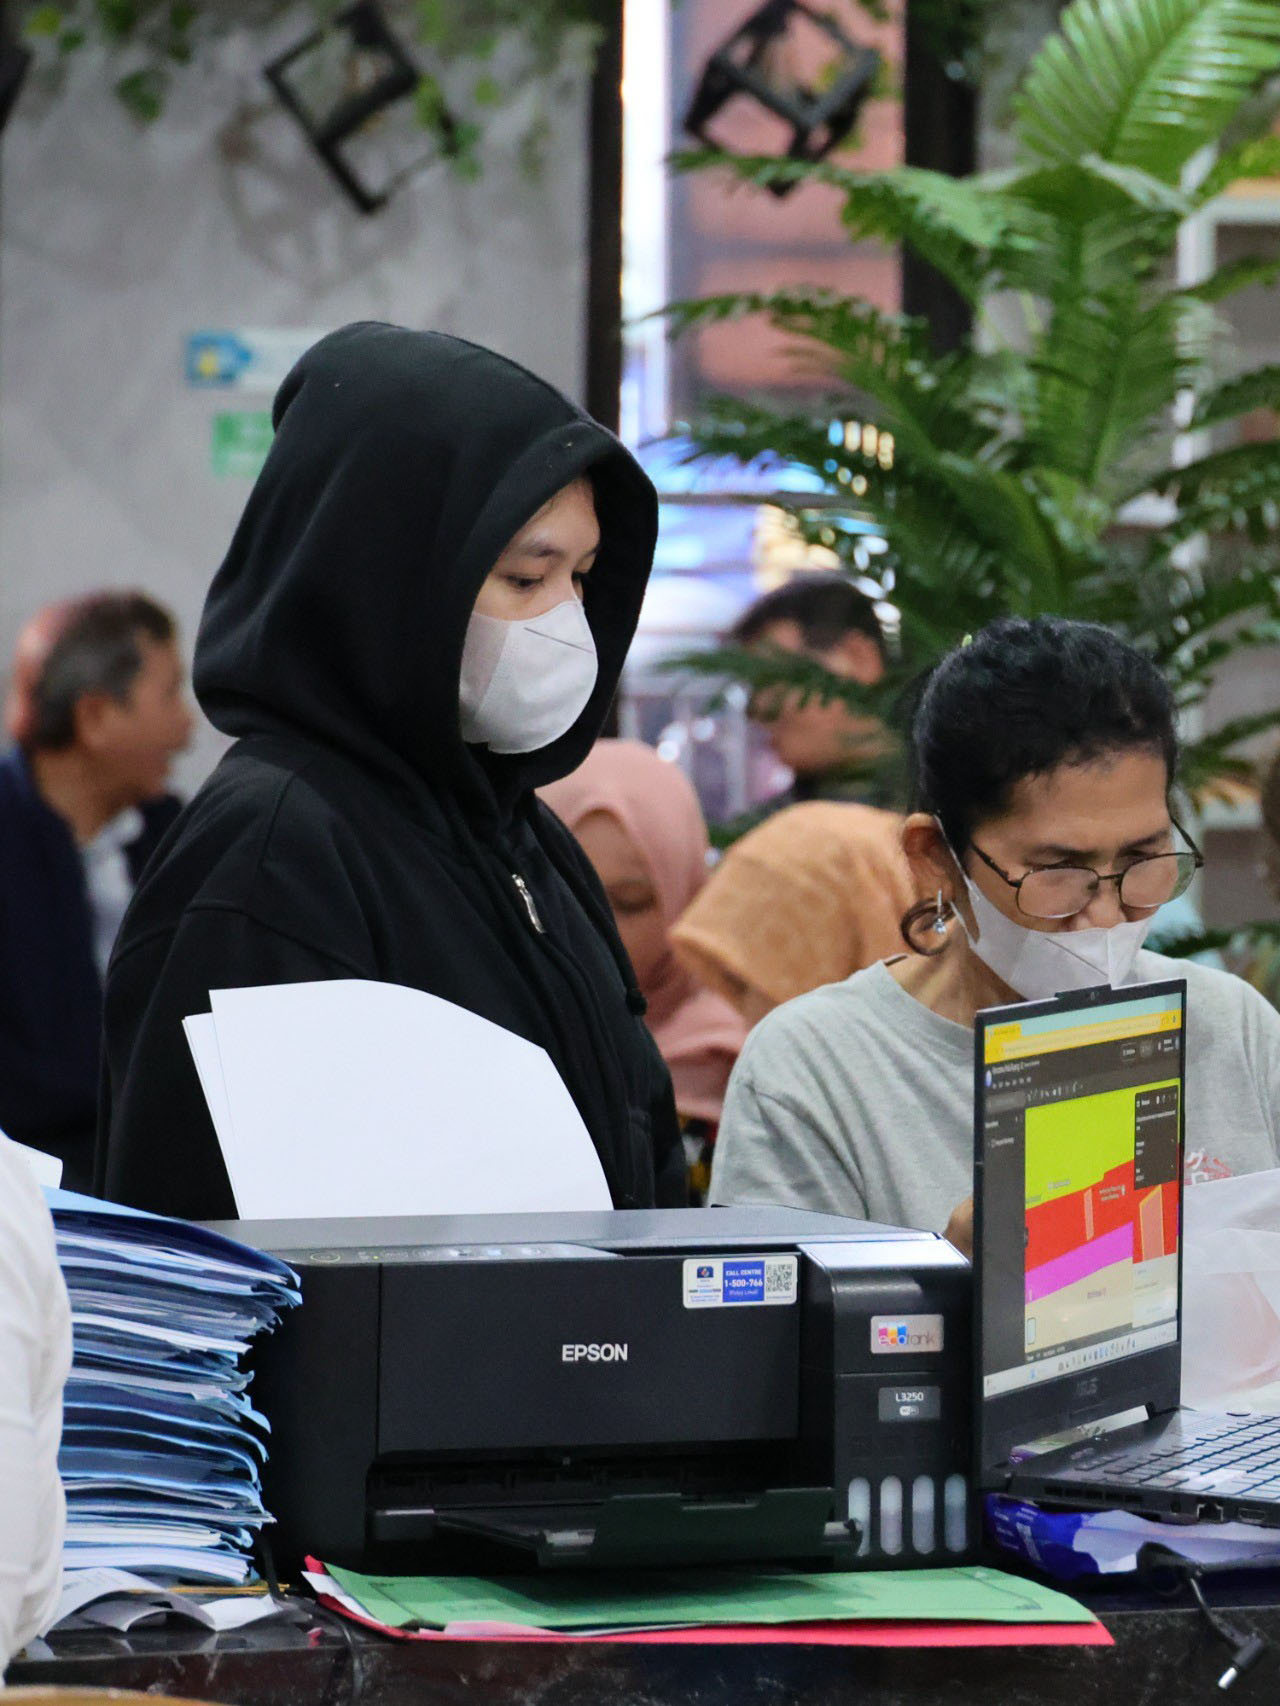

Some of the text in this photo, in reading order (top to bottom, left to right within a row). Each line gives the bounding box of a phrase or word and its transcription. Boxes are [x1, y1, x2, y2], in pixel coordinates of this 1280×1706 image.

[724, 1278, 763, 1288] 1-500-766
[562, 1343, 628, 1362] EPSON
[895, 1391, 924, 1402] L3250
